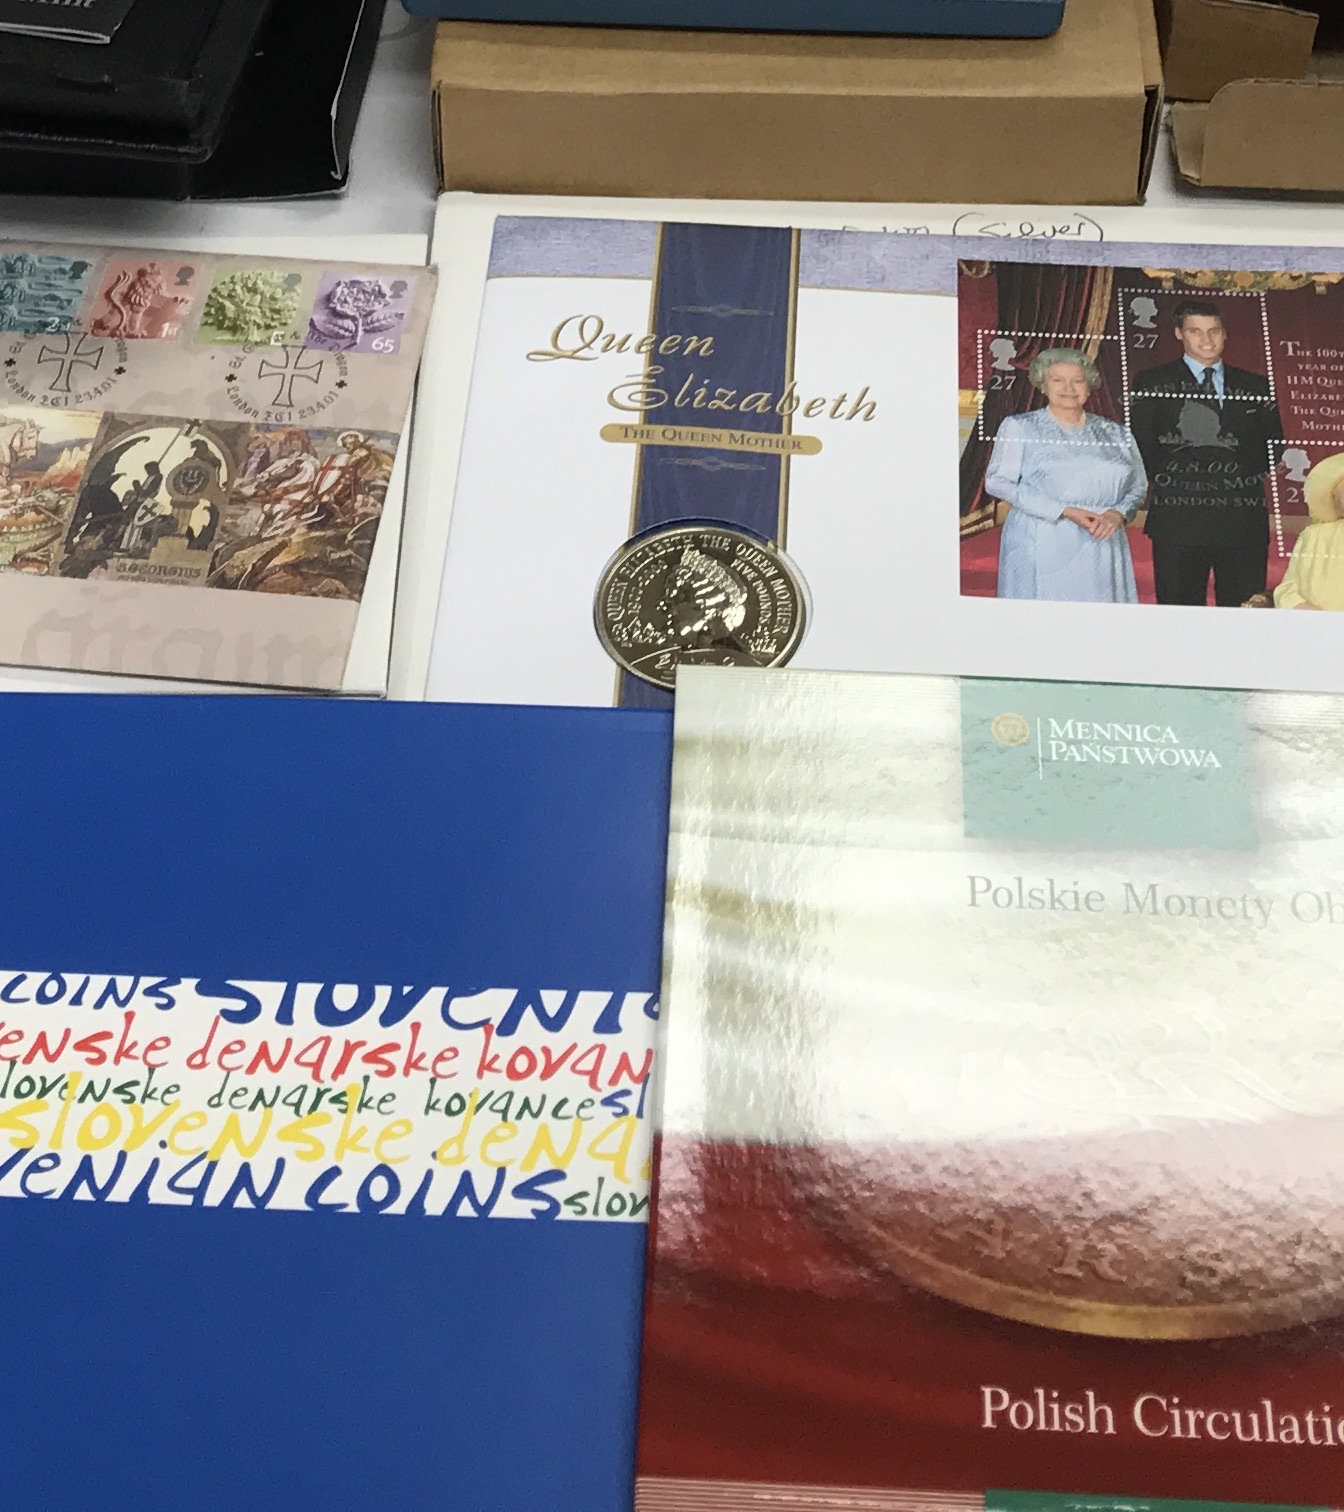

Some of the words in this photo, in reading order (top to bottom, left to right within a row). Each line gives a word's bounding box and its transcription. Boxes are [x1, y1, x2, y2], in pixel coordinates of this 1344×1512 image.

[370, 335, 396, 354] 65
[525, 312, 717, 363] Queen
[1132, 332, 1160, 351] 27
[606, 365, 878, 423] Elizabeth
[989, 374, 1016, 392] 27
[701, 534, 732, 553] THE
[735, 542, 778, 580] QUEEN
[1048, 717, 1180, 745] MENNICA
[1048, 735, 1222, 770] PAŃSTWOWA
[966, 873, 1107, 915] Polskie
[1122, 881, 1275, 926] Monety
[979, 1385, 1117, 1437] Polish
